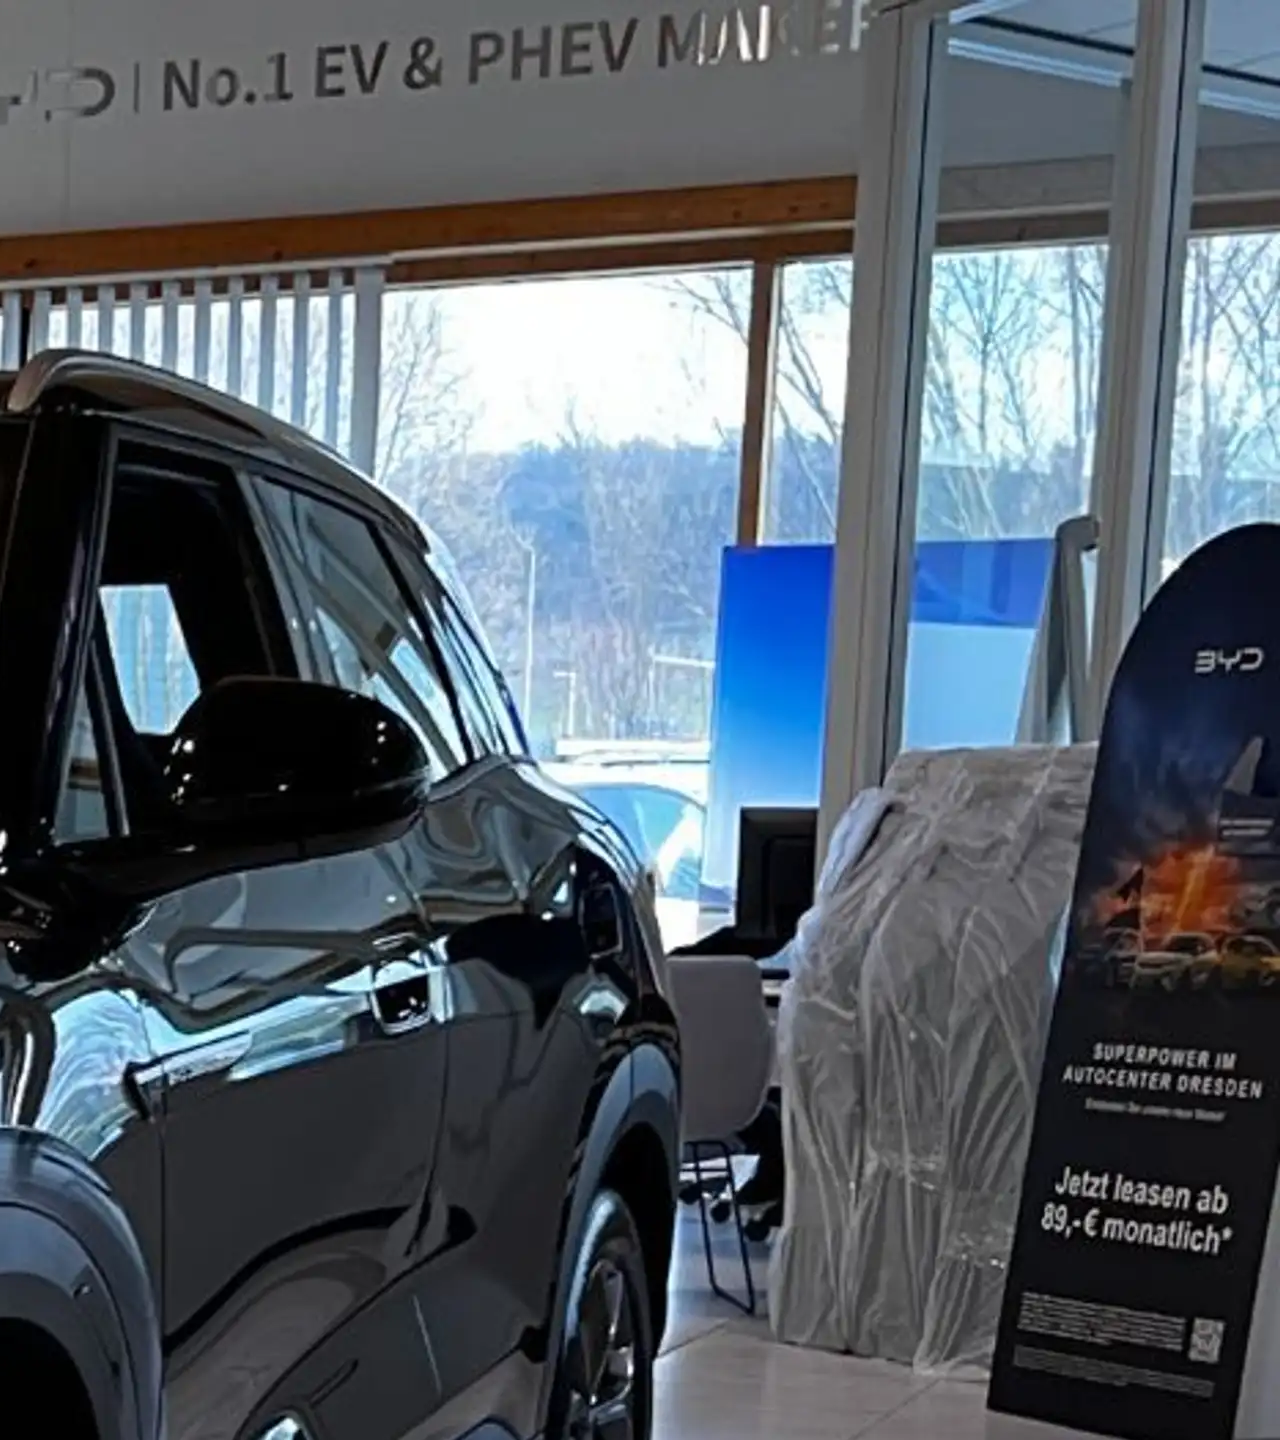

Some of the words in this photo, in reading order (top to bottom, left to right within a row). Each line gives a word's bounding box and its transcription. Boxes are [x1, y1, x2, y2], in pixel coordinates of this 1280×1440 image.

[161, 52, 293, 113] No.1
[314, 43, 388, 98] EV
[403, 35, 441, 91] &
[466, 18, 638, 85] PHEV
[1194, 647, 1264, 674] BYD
[1093, 1042, 1210, 1069] SUPERPOWER
[1214, 1053, 1237, 1070] IM
[1062, 1065, 1172, 1091] AUTOCENTER
[1176, 1075, 1263, 1099] DRESDEN
[1055, 1166, 1109, 1200] Jetzt
[1113, 1174, 1190, 1210] leasen
[1196, 1185, 1229, 1215] ab
